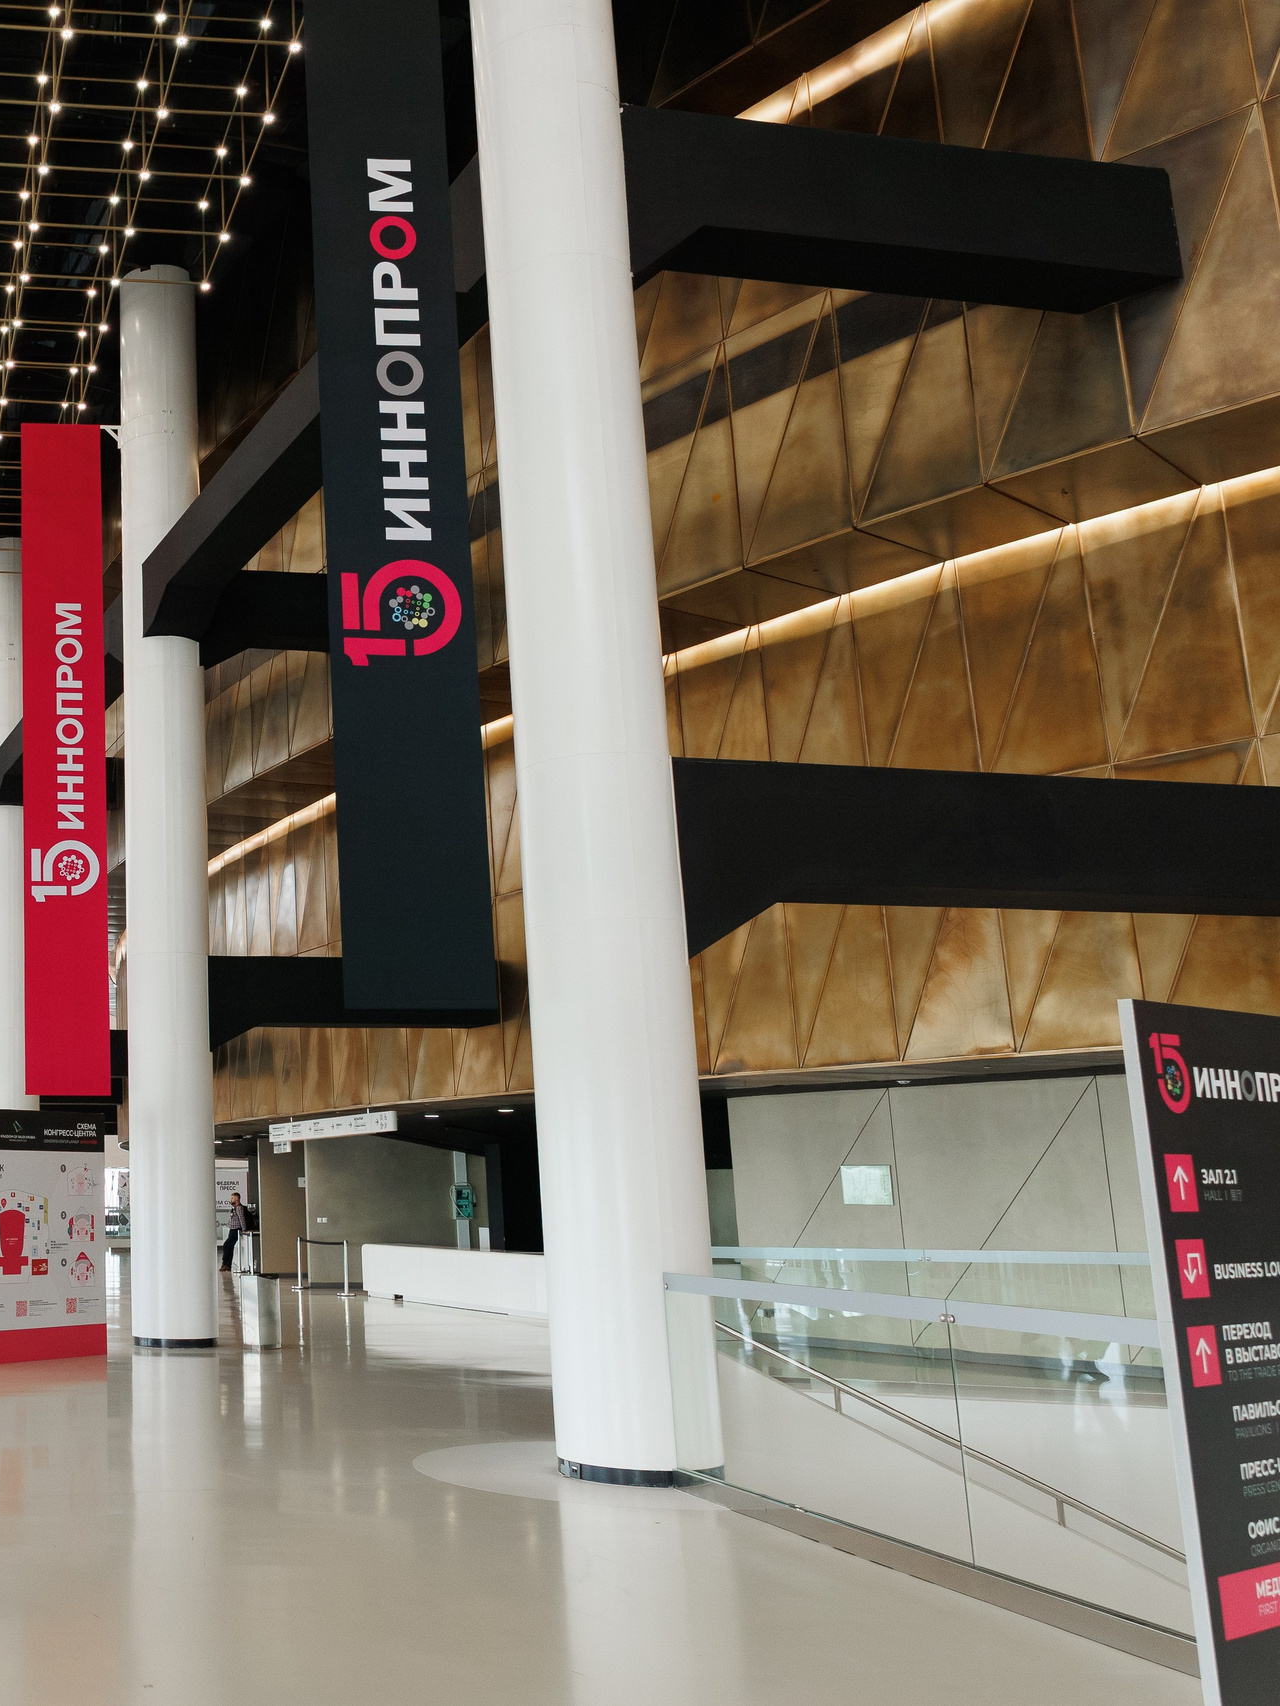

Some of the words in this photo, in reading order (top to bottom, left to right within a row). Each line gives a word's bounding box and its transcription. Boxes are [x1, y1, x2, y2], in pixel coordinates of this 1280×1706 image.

[367, 158, 432, 541] ИННОПРОМ
[55, 602, 84, 829] ИННОПРОМ
[43, 1129, 97, 1138] КОНГРЕСС-ЦЕНТРА
[76, 1122, 97, 1130] СХЕМА
[1201, 1169, 1224, 1185] ЗАЛ
[1224, 1169, 1238, 1185] 2.1
[1203, 1189, 1223, 1201] HALL
[1213, 1262, 1264, 1280] BUSINESS
[1222, 1321, 1273, 1341] ПЕРЕХОД
[1224, 1348, 1234, 1365] В
[1227, 1369, 1238, 1382] TO
[1238, 1368, 1253, 1381] THE
[1258, 1600, 1279, 1617] FIRST
